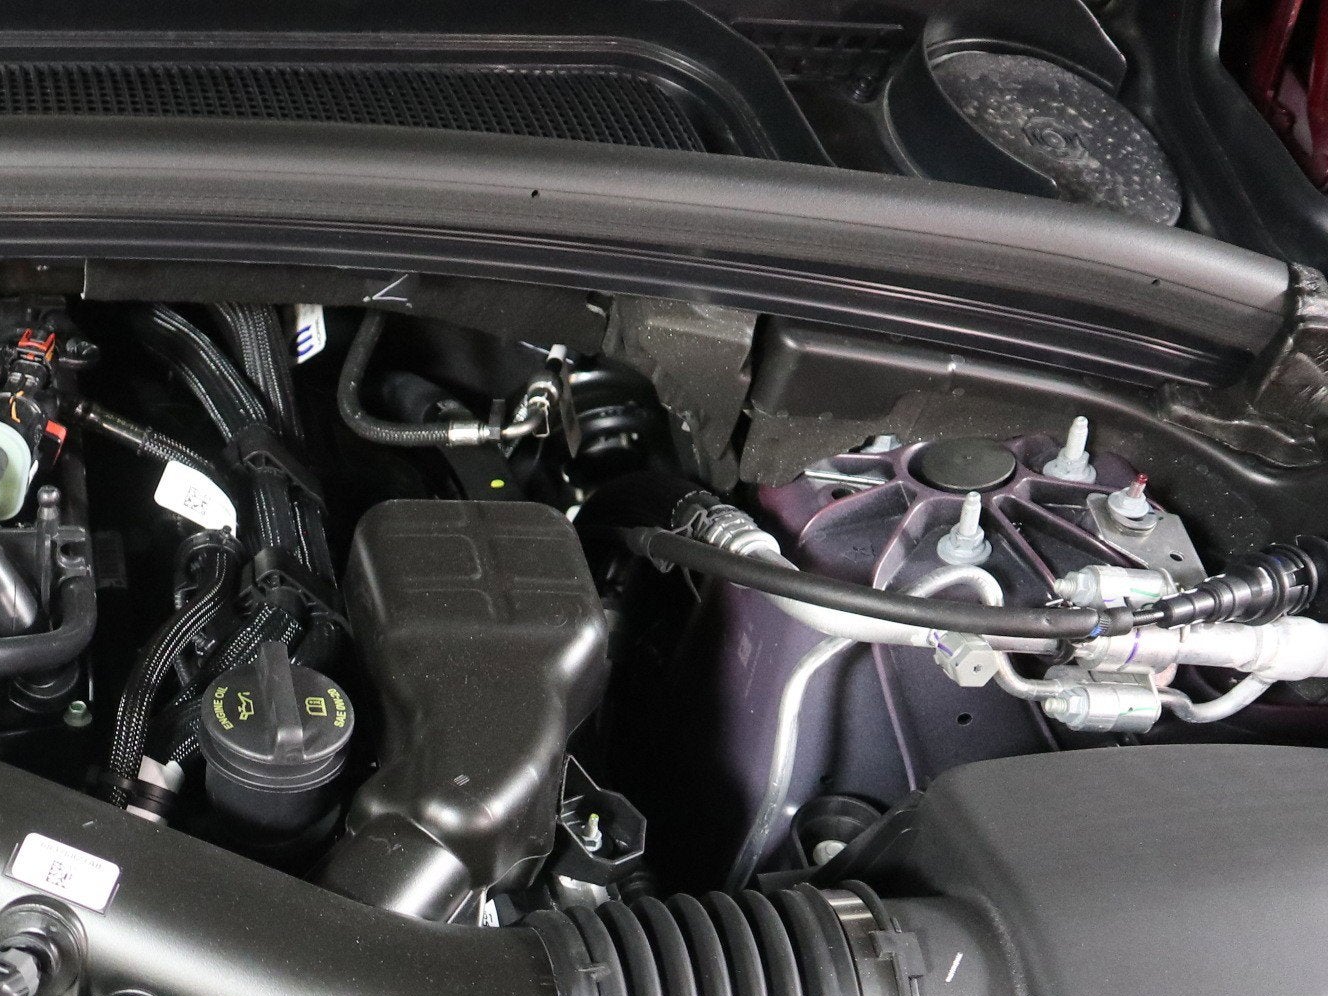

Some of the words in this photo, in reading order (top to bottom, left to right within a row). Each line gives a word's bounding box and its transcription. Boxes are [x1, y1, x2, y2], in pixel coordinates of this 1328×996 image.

[214, 686, 228, 699] OIL
[213, 700, 234, 730] ENGINE
[333, 710, 347, 728] SAE
